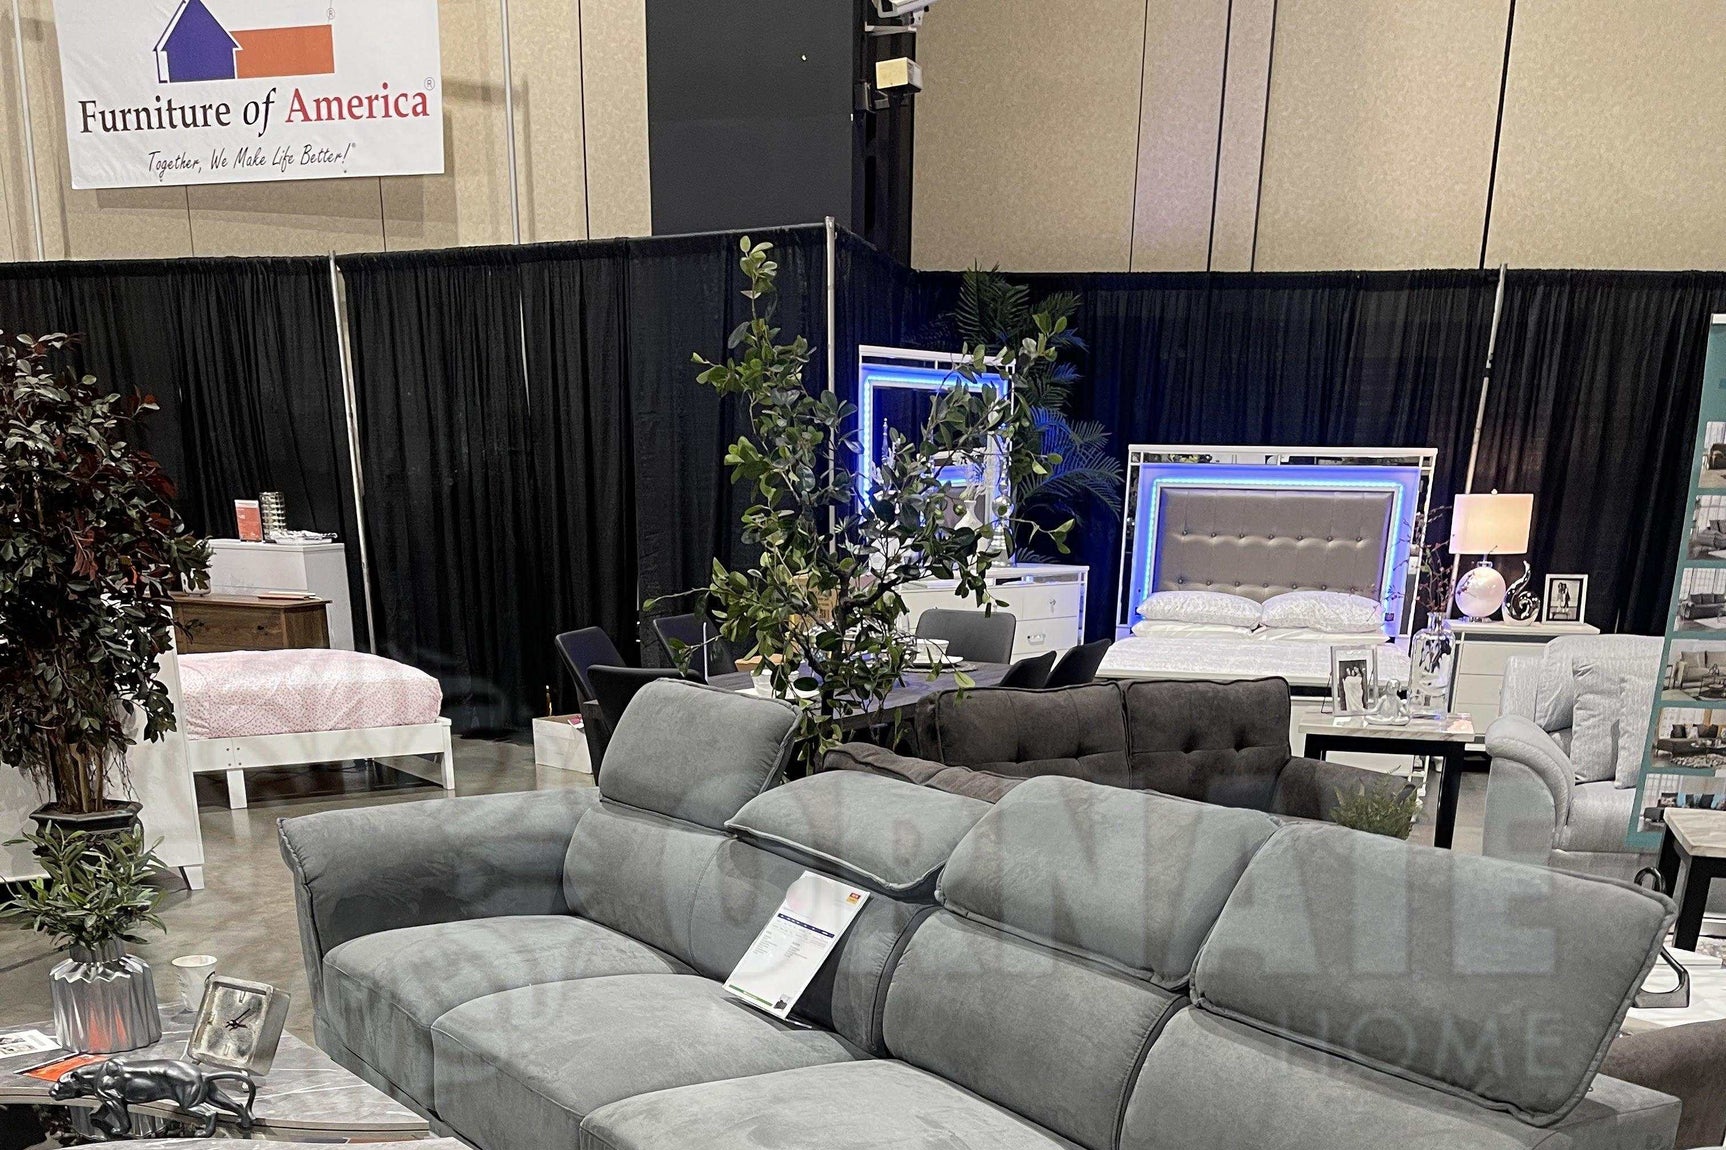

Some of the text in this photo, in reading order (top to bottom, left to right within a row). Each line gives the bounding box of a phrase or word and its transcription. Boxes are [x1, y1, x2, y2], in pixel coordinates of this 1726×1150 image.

[78, 95, 231, 134] Furniture
[243, 87, 277, 138] of
[148, 142, 351, 178] Together, We Make Life Better!
